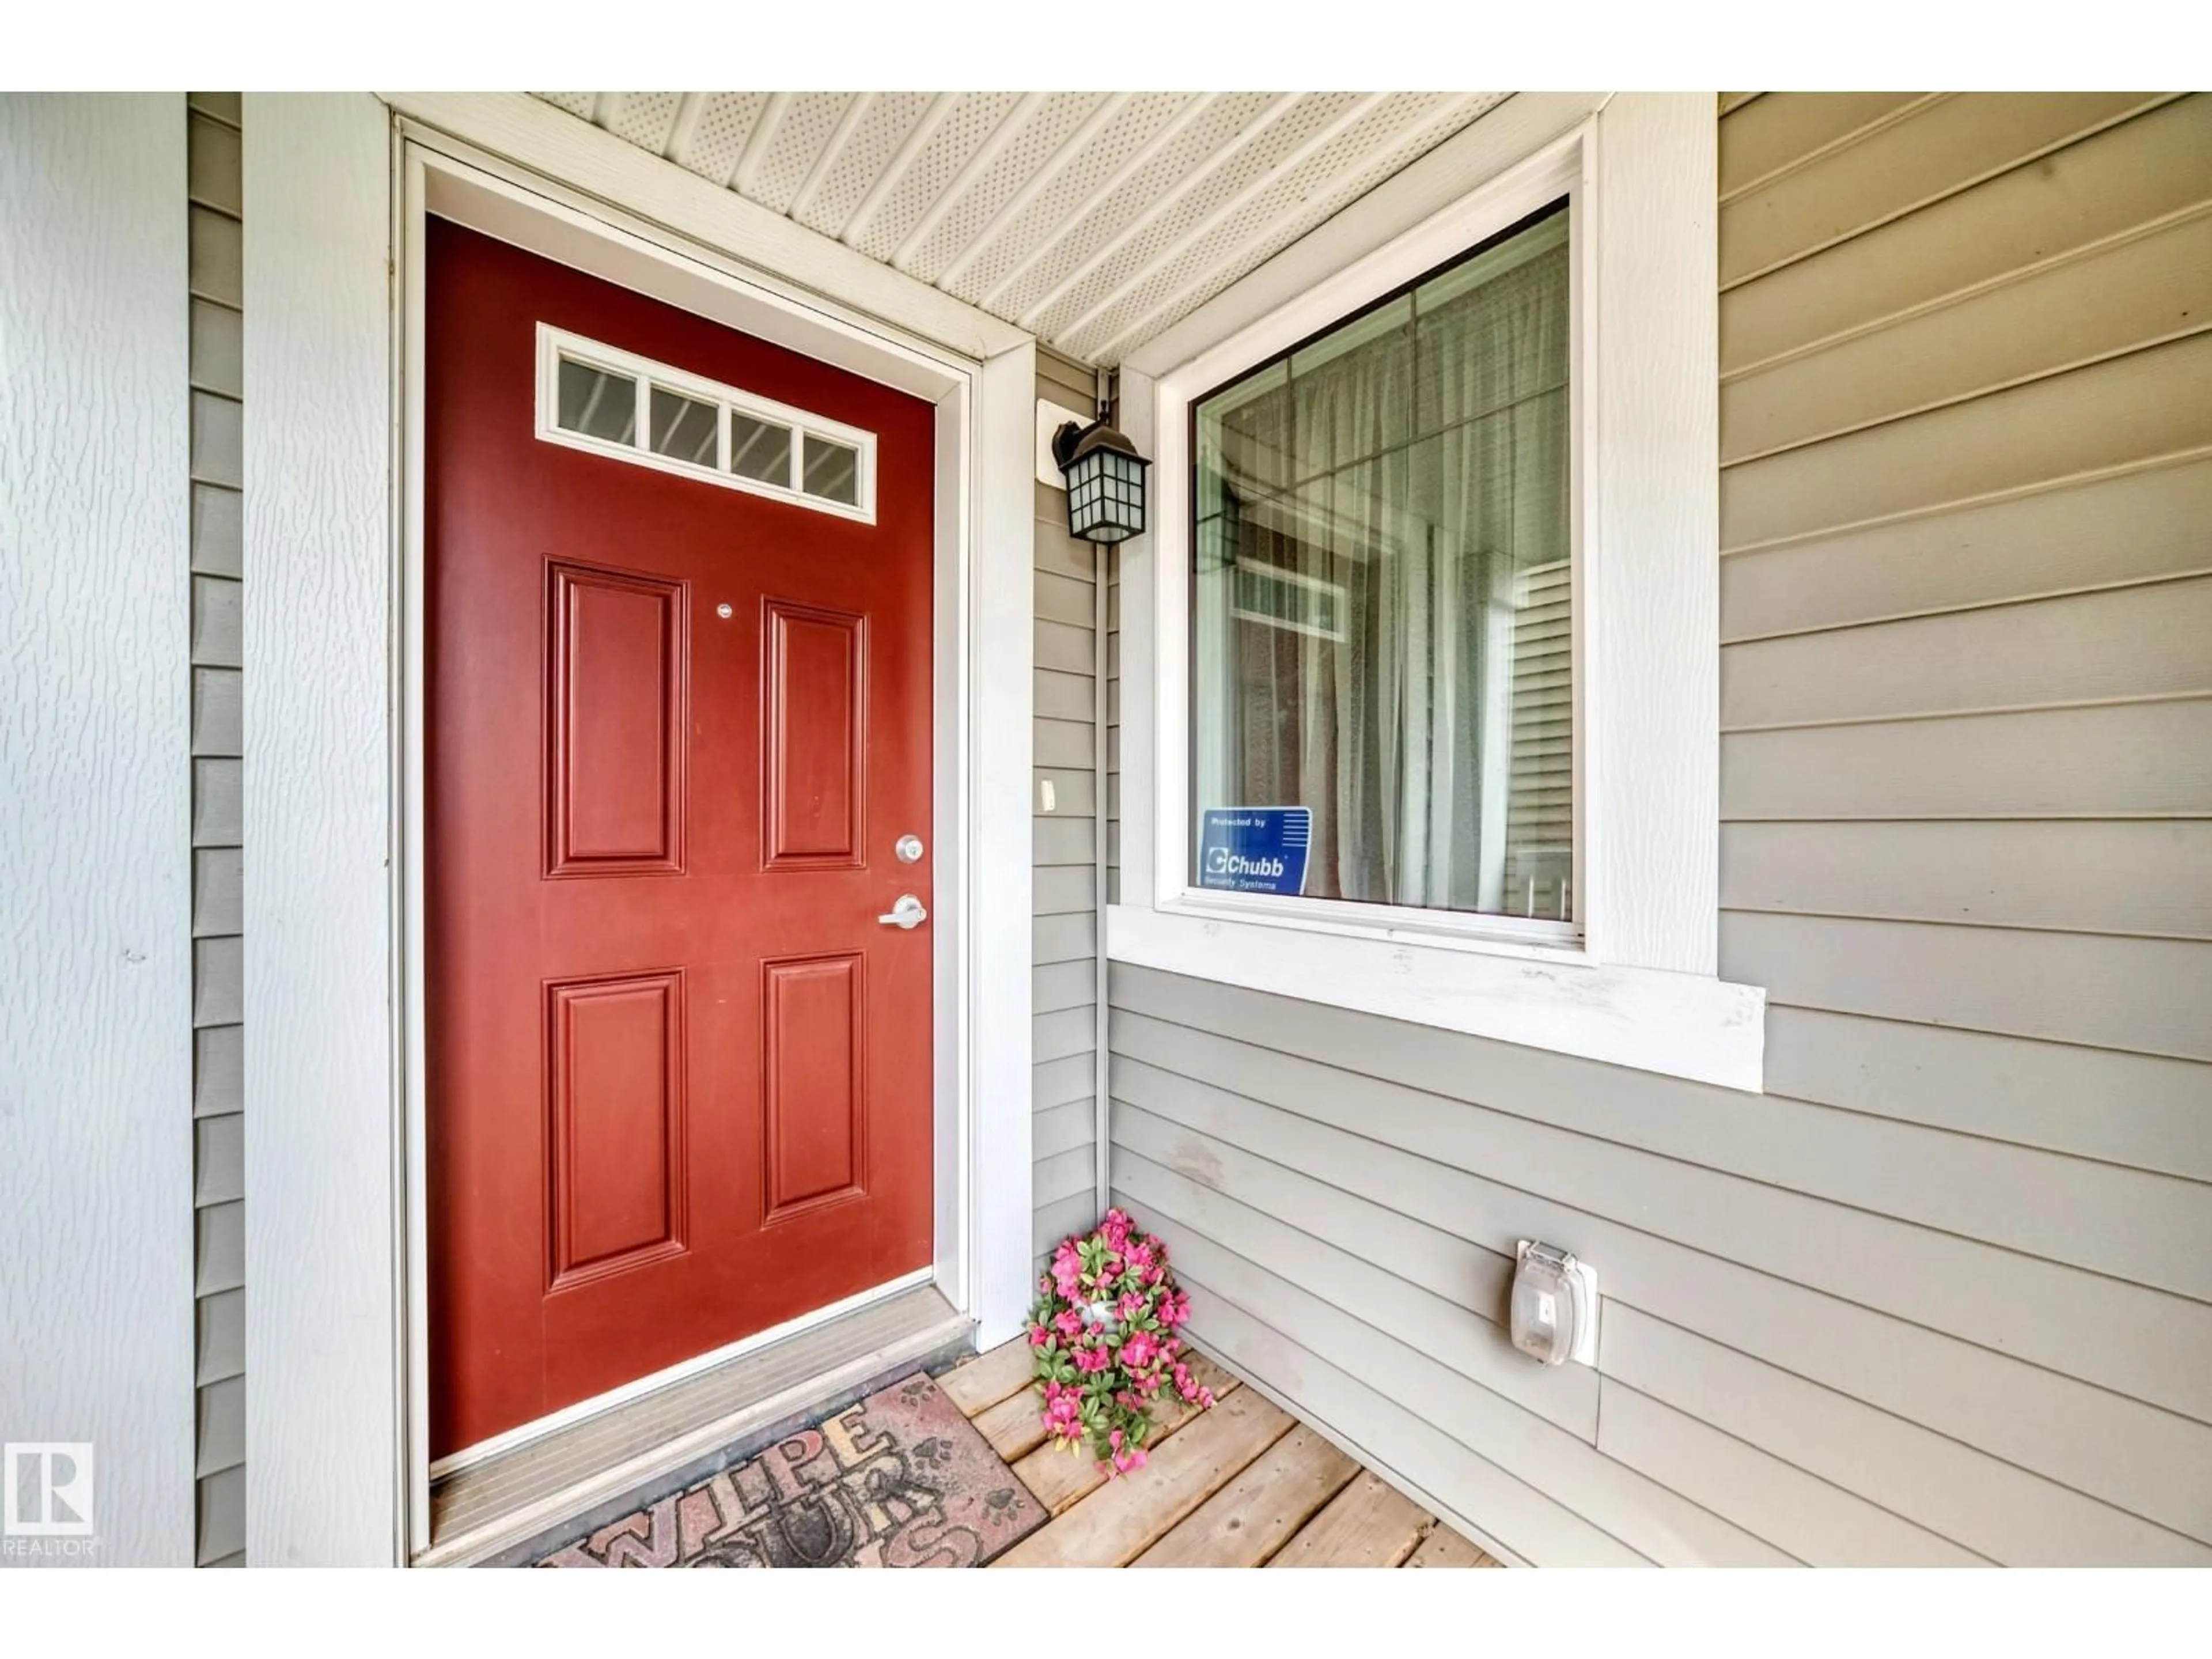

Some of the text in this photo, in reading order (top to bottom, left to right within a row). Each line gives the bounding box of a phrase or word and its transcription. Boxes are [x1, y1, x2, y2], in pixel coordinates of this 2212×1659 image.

[1255, 818, 1266, 828] by
[1228, 855, 1284, 877] Chubb
[532, 1403, 893, 1567] WIPE
